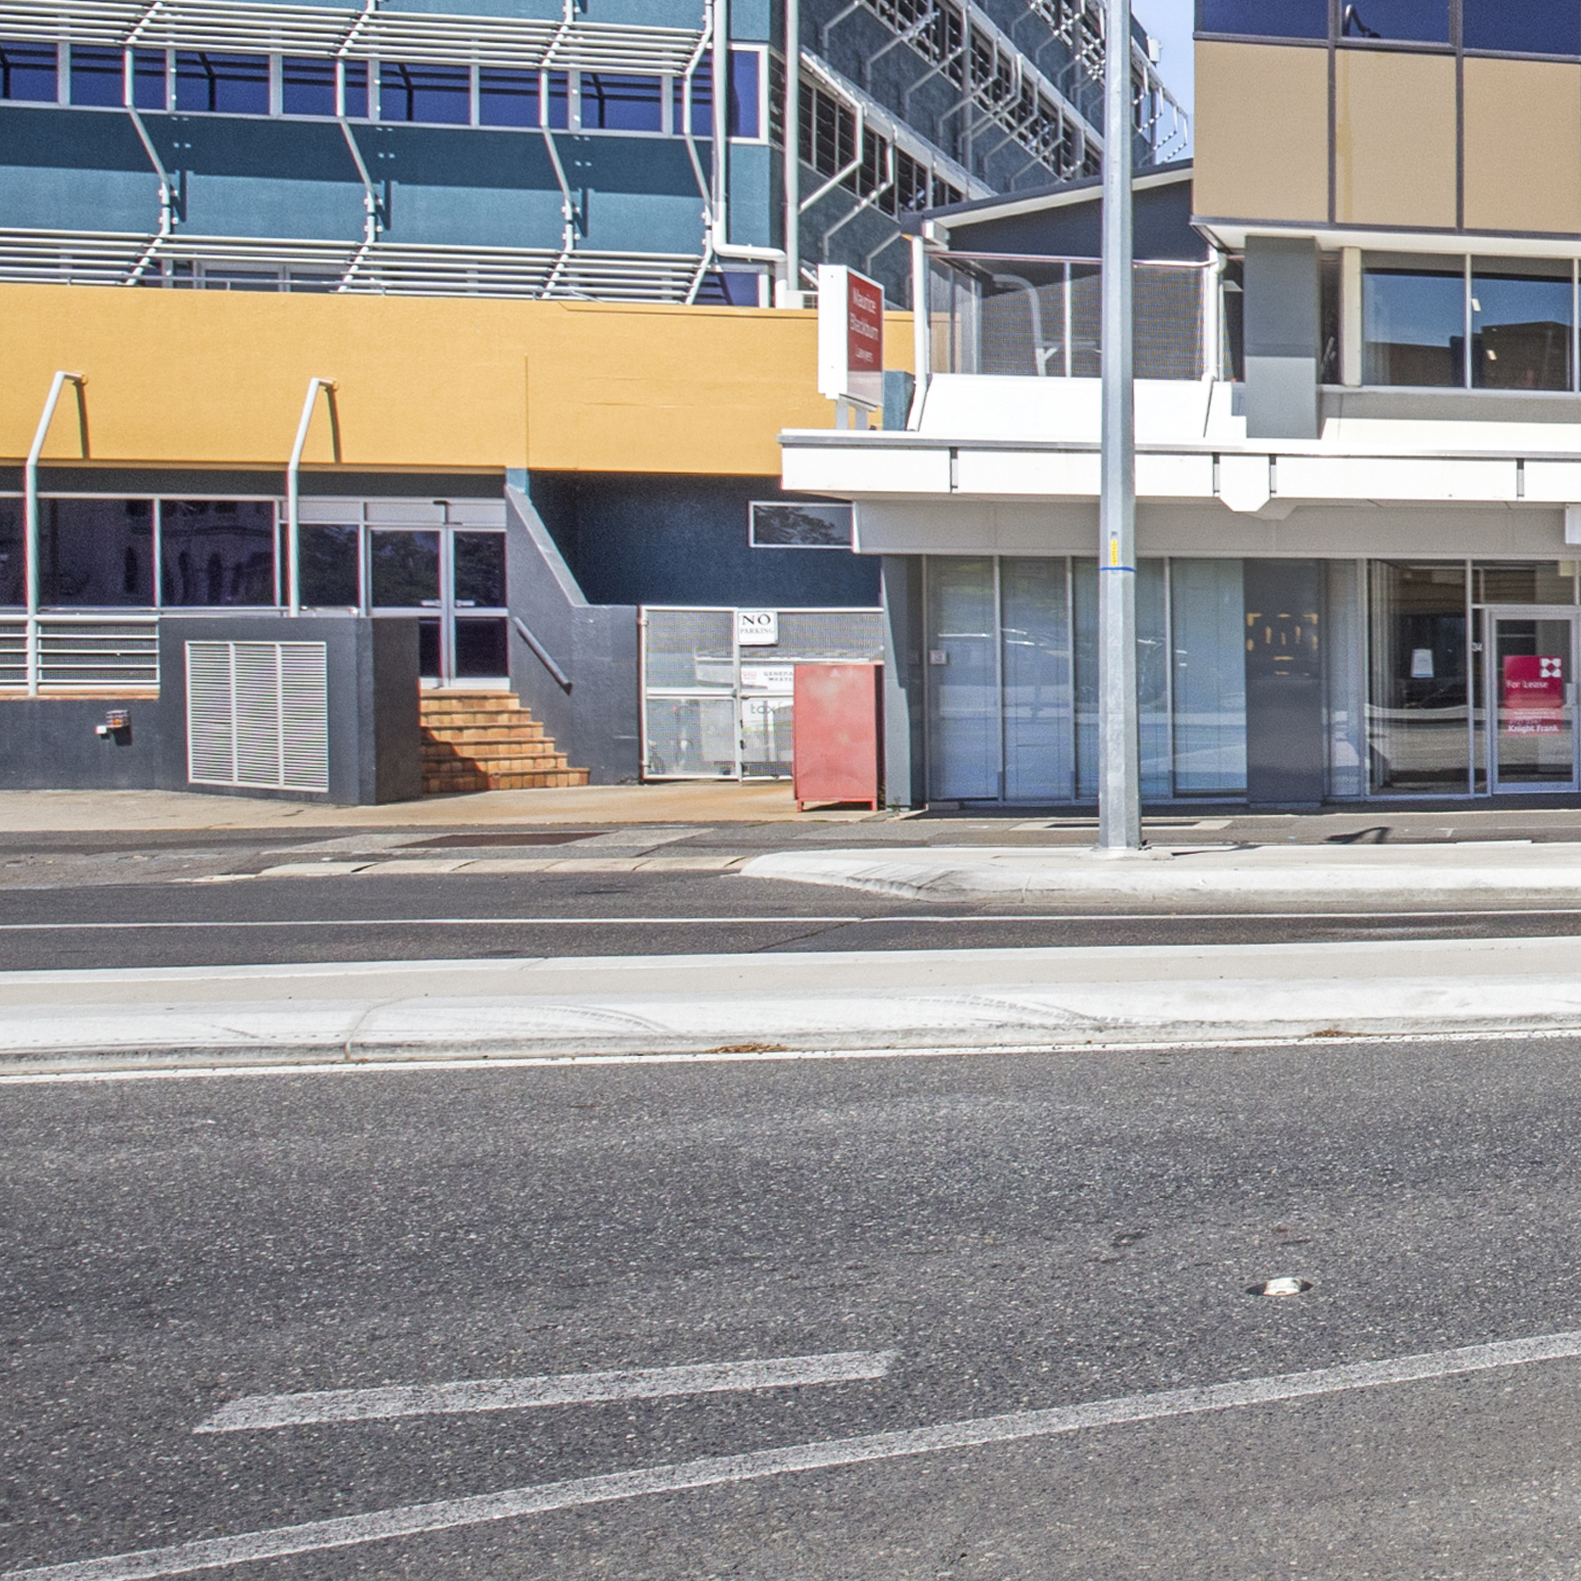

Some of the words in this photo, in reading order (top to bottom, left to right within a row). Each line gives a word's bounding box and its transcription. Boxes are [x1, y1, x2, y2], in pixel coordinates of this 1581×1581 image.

[742, 613, 771, 625] NO
[1505, 680, 1521, 689] For
[1523, 680, 1549, 689] Lease
[1508, 724, 1535, 734] Knight
[1537, 724, 1560, 732] Frank
